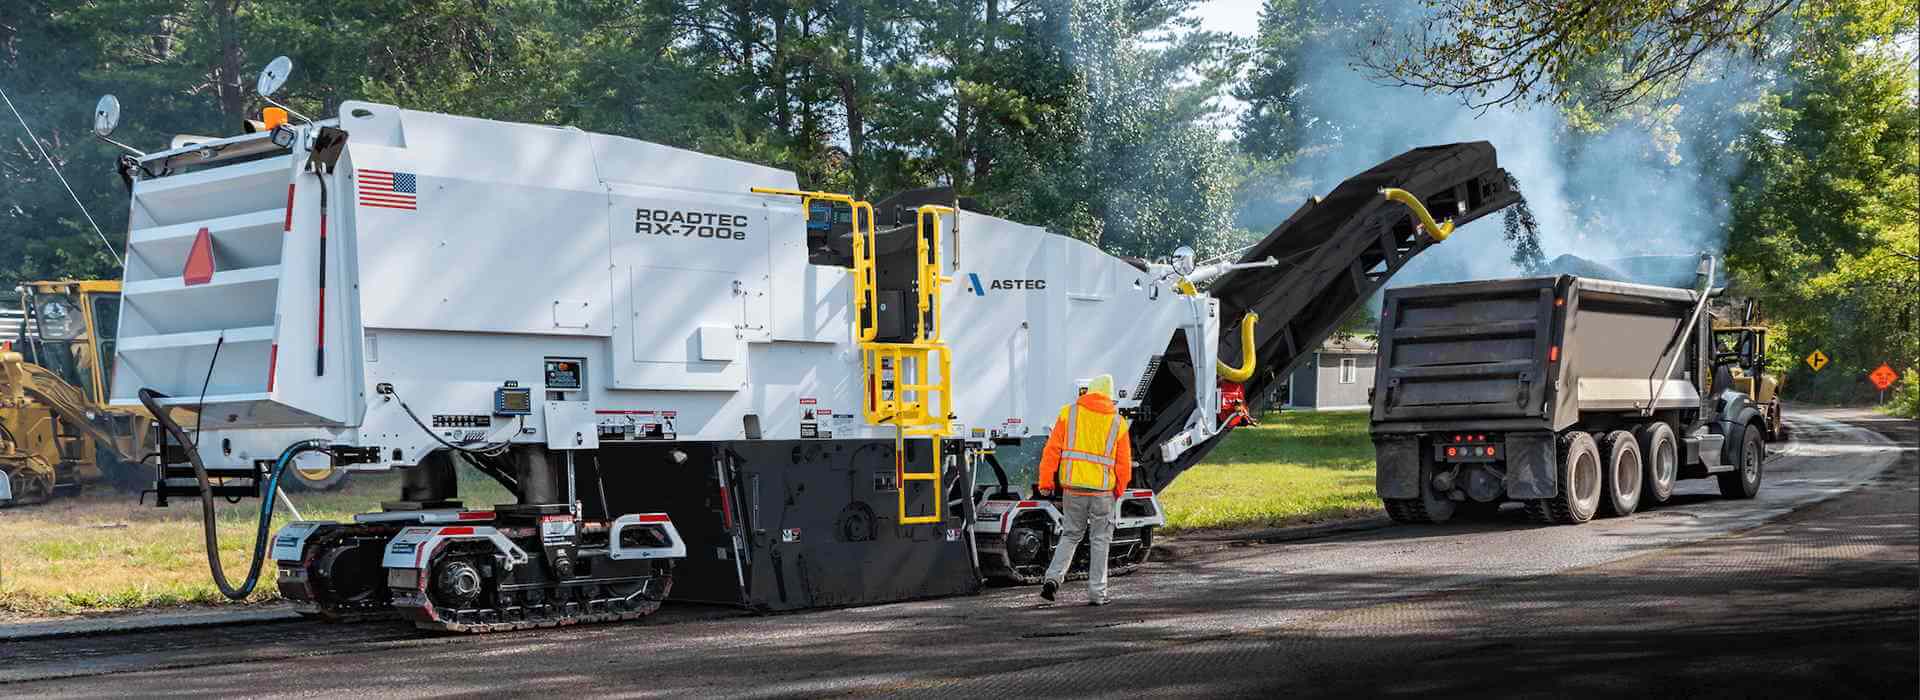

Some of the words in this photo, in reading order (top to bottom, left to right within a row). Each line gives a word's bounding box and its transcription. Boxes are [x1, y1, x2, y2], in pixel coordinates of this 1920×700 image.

[636, 208, 748, 227] ROADTEC
[635, 221, 746, 241] RX-700e
[990, 279, 1047, 290] ASTEC
